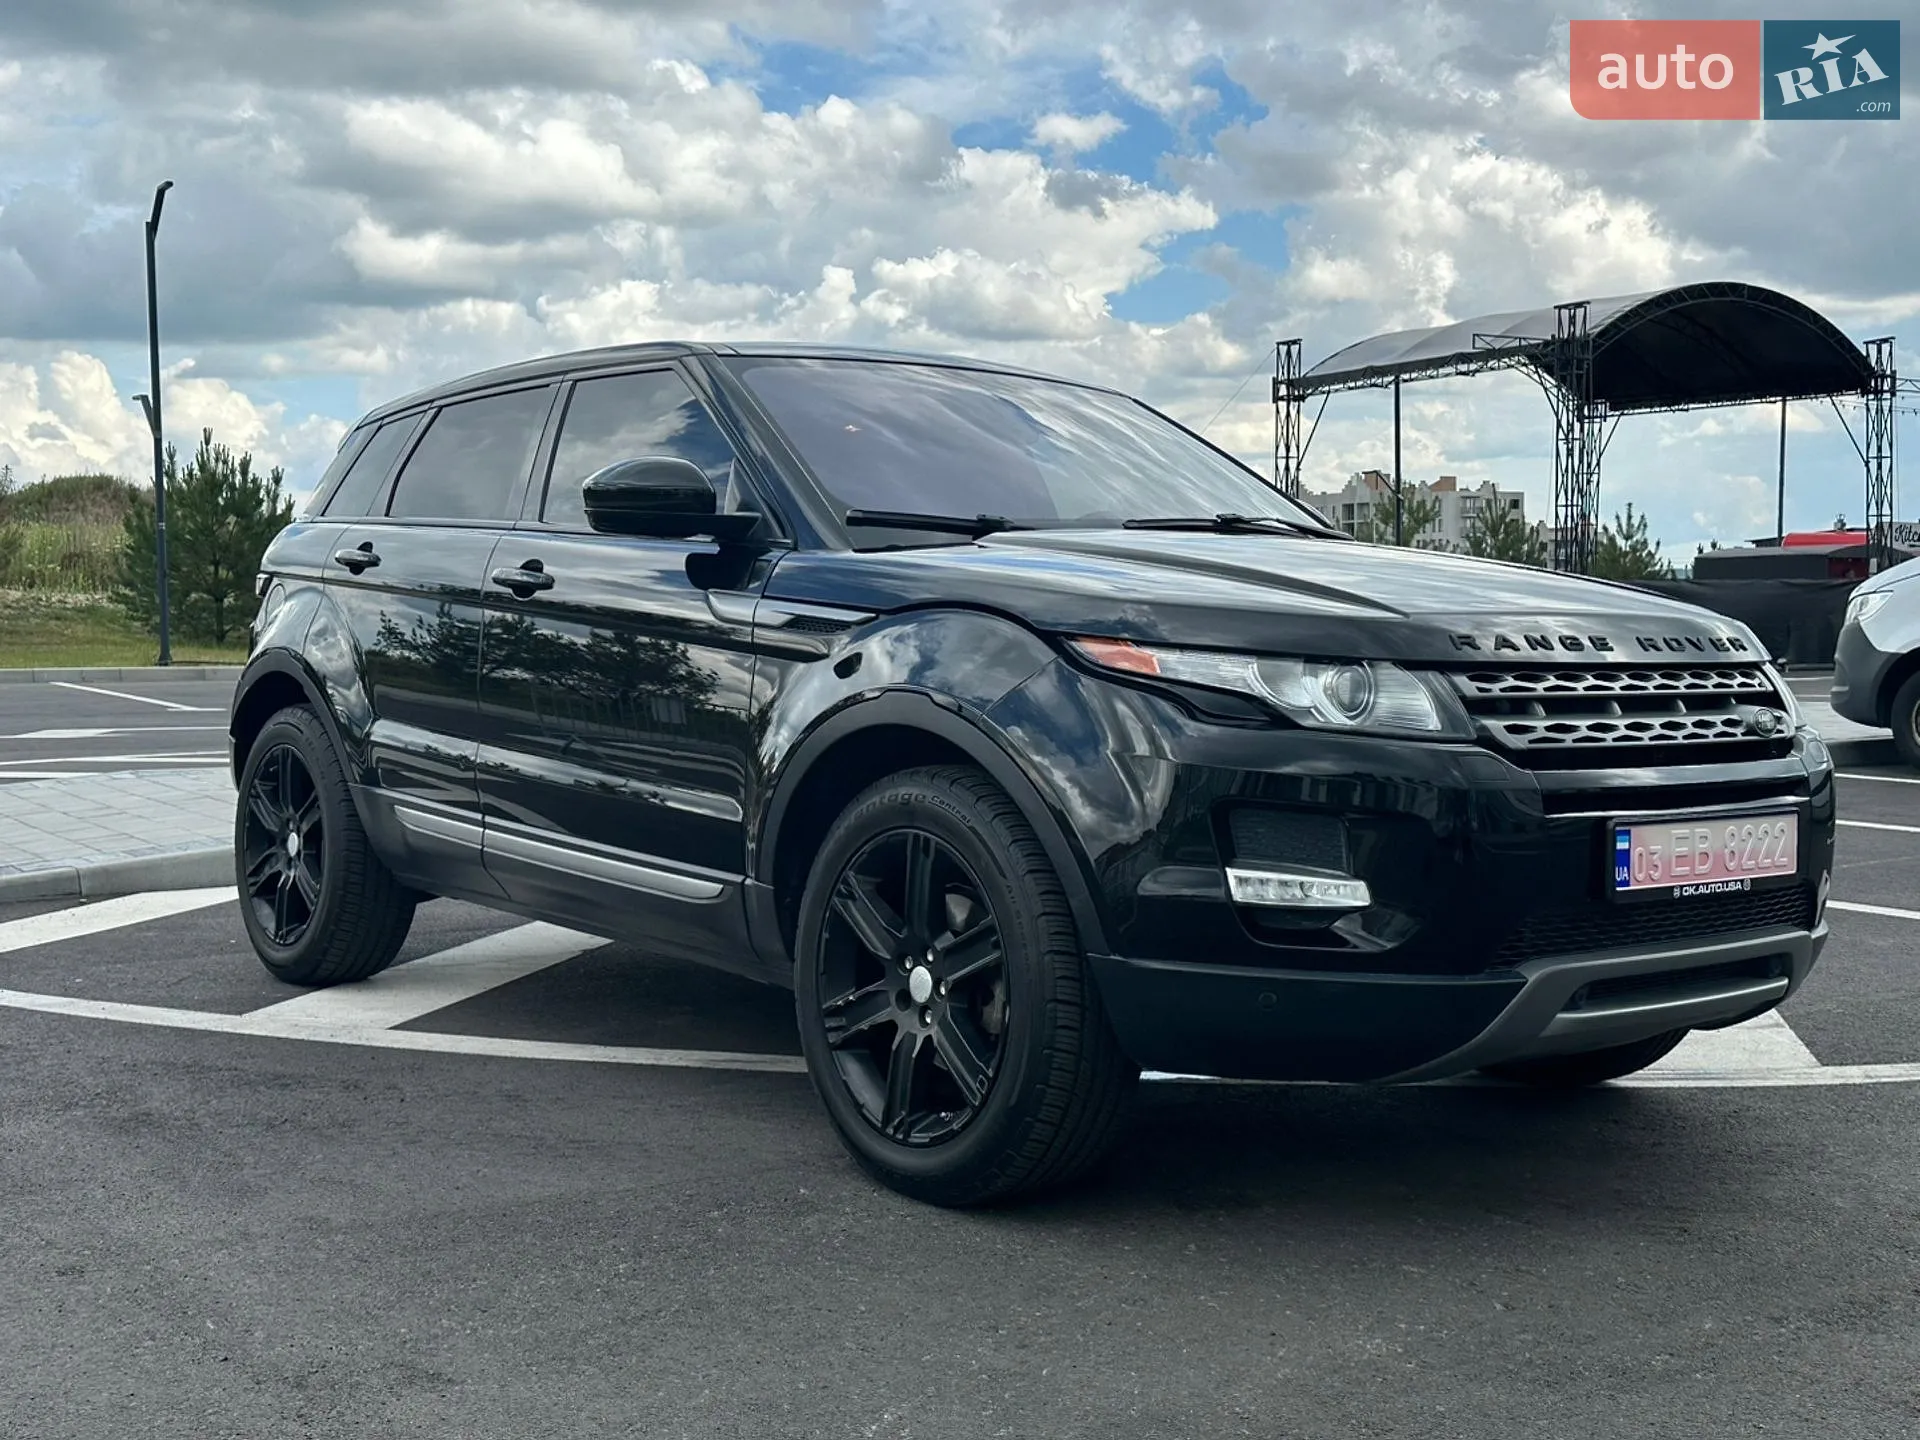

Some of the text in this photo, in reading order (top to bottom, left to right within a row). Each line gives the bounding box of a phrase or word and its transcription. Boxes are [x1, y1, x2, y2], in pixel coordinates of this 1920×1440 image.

[1894, 524, 1920, 545] Kitc
[1449, 633, 1749, 652] RANGE ROVER
[1633, 821, 1788, 882] 03 EB 8222
[1616, 866, 1629, 881] UA
